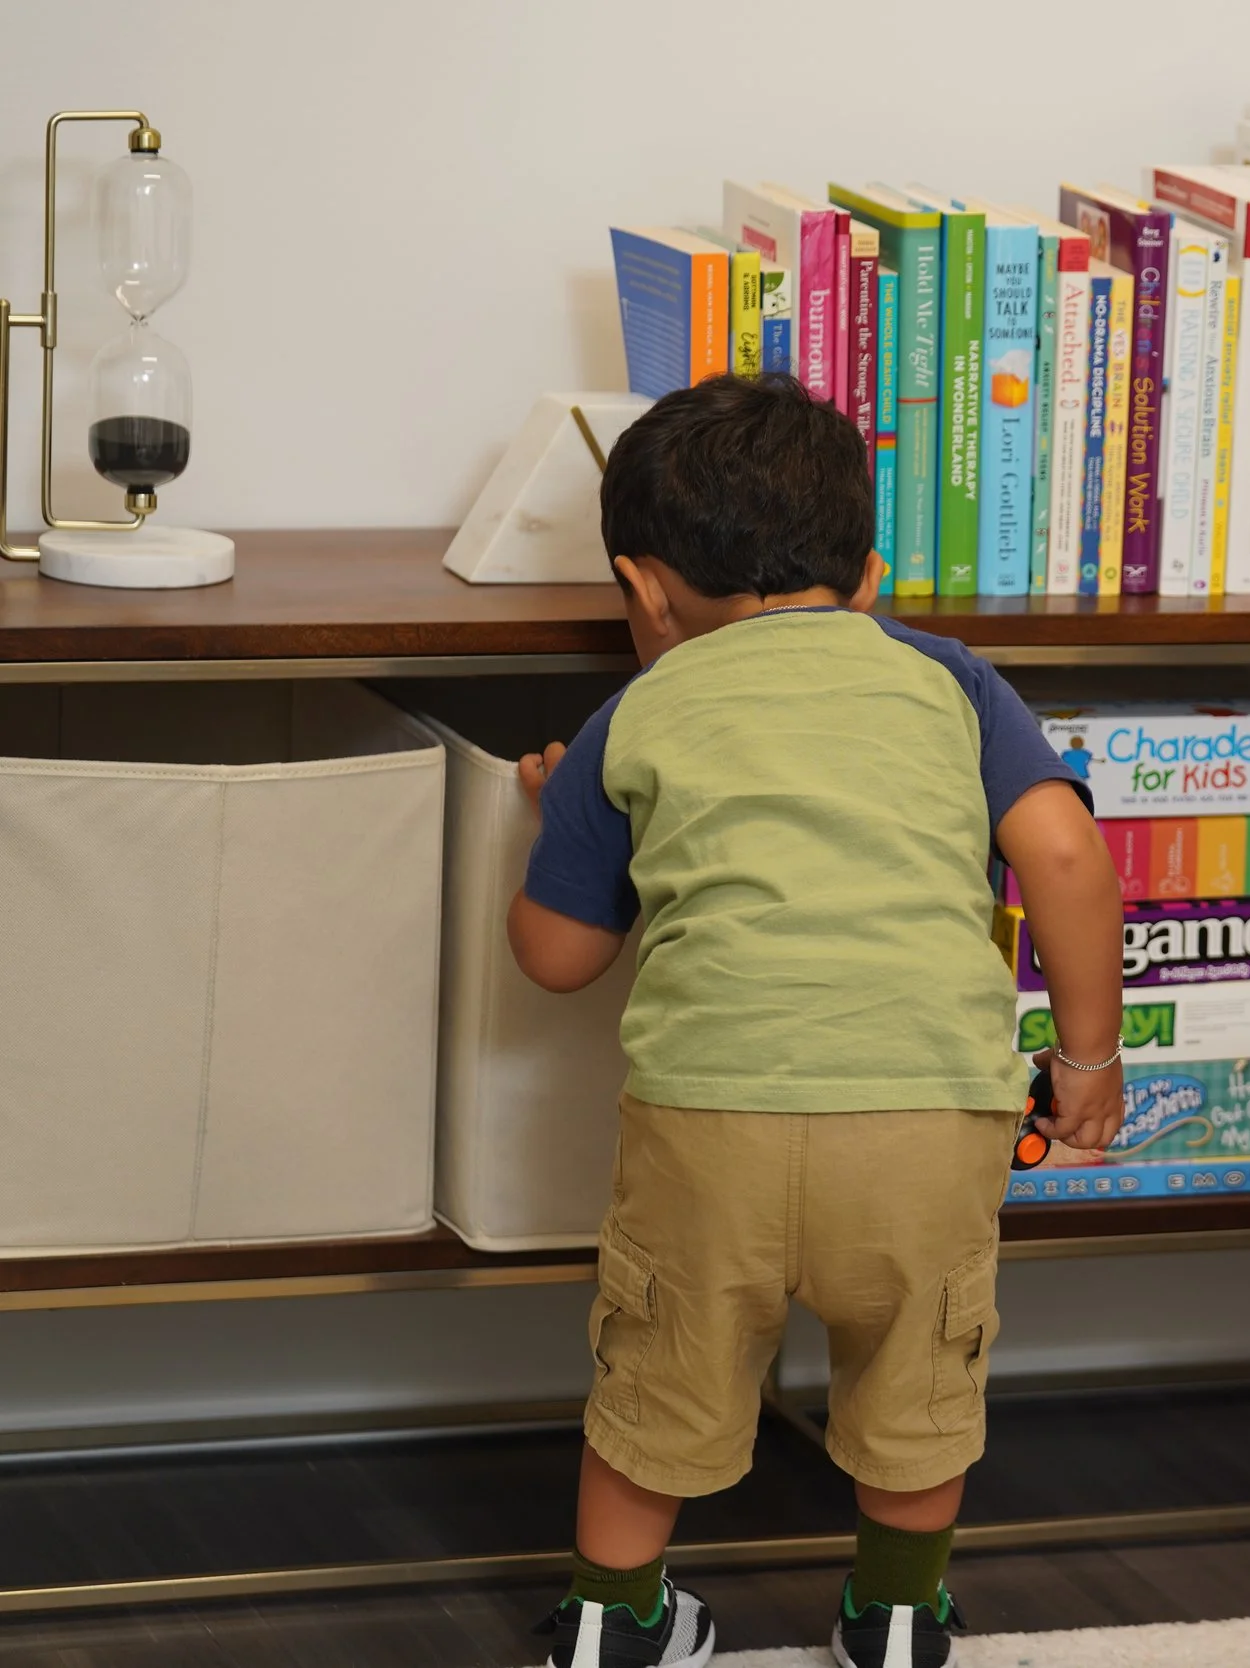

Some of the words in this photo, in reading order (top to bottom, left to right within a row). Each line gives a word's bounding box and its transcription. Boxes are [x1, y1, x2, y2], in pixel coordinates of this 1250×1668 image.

[917, 245, 935, 294] Hold
[996, 262, 1030, 275] MAYBE
[1006, 277, 1022, 286] YOU
[855, 261, 874, 325] Parenting
[884, 282, 894, 303] THE
[917, 301, 934, 329] Me
[993, 287, 1033, 299] SHOULD
[995, 301, 1029, 316] TALK
[1115, 300, 1126, 324] THE
[1207, 280, 1223, 329] Rewire
[772, 323, 783, 344] The
[807, 289, 830, 389] burnout
[858, 328, 873, 350] the
[989, 327, 1034, 340] SOMEONE
[1007, 317, 1017, 326] TO
[1060, 283, 1084, 392] Attached.
[1093, 294, 1107, 366] NO-DRAMA
[1136, 266, 1161, 371] Children's
[1226, 297, 1236, 336] social
[883, 306, 893, 386] WHOLE-BRAIN
[908, 333, 934, 388] Tight
[953, 355, 965, 373] IN
[1113, 330, 1126, 358] YES
[1178, 308, 1199, 382] RAISING
[1222, 341, 1232, 387] anxiety
[882, 388, 893, 424] CHILD
[967, 340, 979, 426] NARRATIVE
[1090, 367, 1105, 438] DISCIPLINE
[1112, 362, 1124, 408] BRAIN
[1179, 387, 1195, 402] A
[1202, 354, 1219, 416] Anxious
[1131, 377, 1156, 465] Solution
[1220, 389, 1231, 425] relief
[951, 376, 964, 487] WONDERLAND
[1001, 417, 1020, 463] Lori
[1173, 405, 1195, 465] SECURE
[1201, 417, 1216, 458] Brain
[964, 431, 978, 500] THERAPY
[999, 472, 1019, 561] Gottlieb
[1127, 472, 1151, 534] Work
[1171, 471, 1191, 520] CHILD
[1131, 762, 1176, 792] for
[1182, 761, 1248, 793] Kids
[1211, 1103, 1243, 1128] Get
[1221, 1125, 1250, 1151] My
[1011, 1176, 1139, 1197] MIXED
